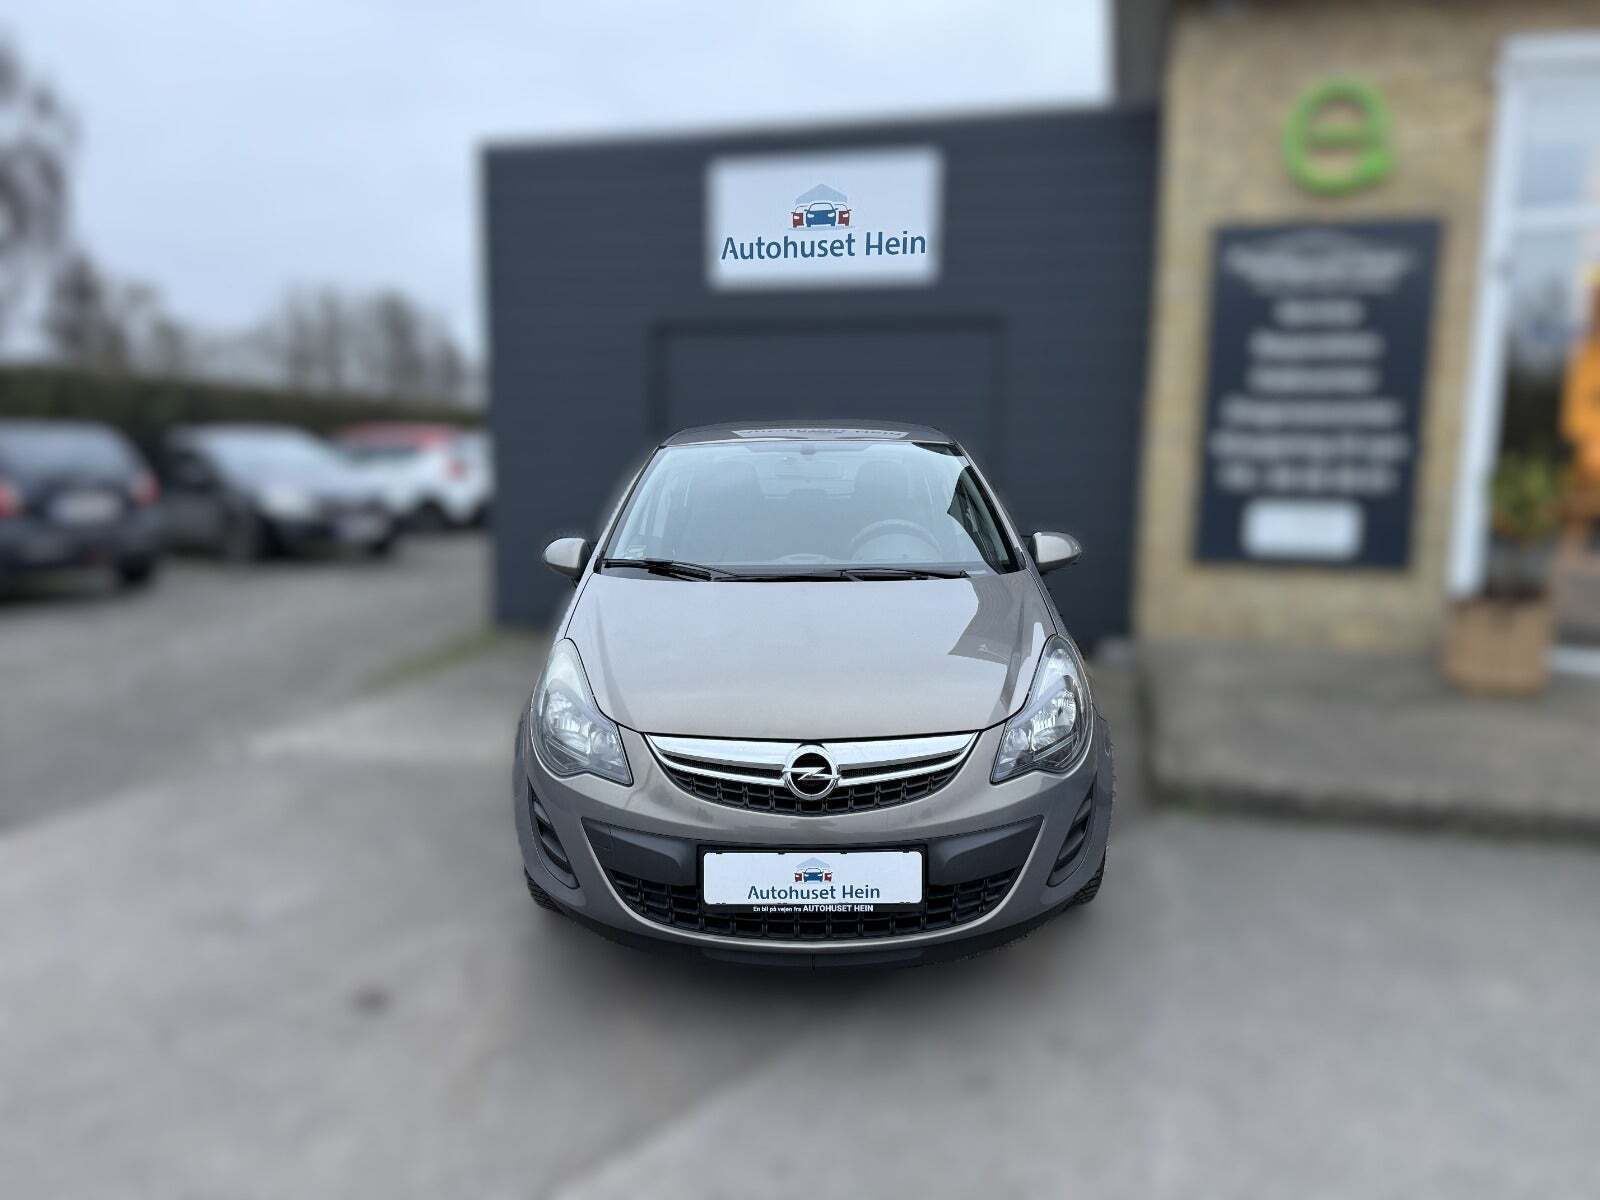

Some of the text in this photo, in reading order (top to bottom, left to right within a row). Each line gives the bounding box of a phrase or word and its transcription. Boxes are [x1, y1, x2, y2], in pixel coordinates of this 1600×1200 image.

[721, 231, 927, 260] Autohuset Hein
[747, 885, 881, 900] Autohuset Hein
[854, 904, 874, 912] HEIN
